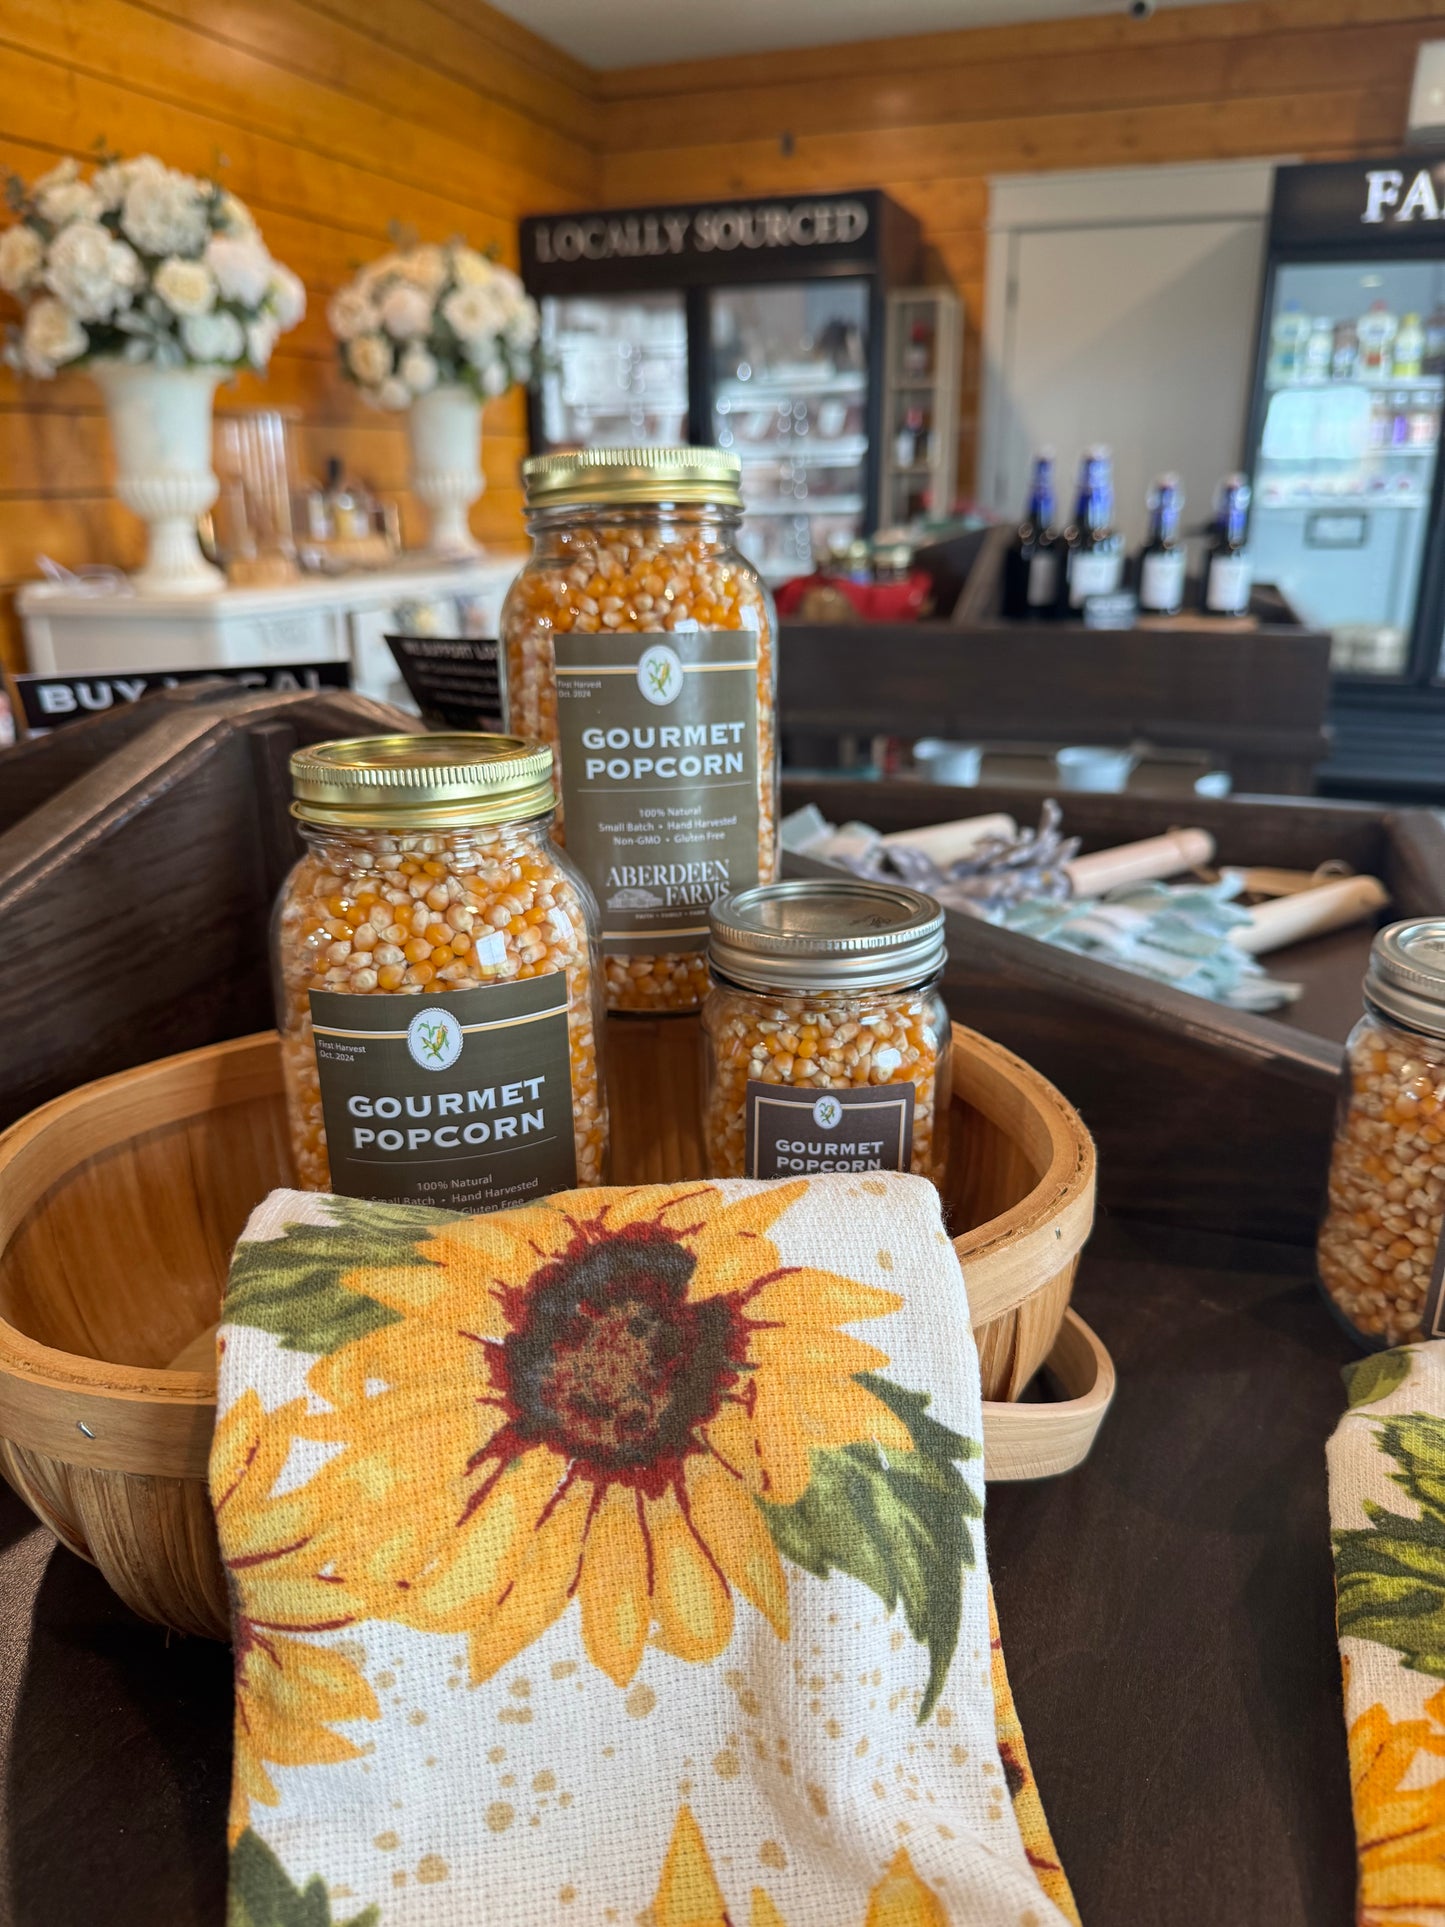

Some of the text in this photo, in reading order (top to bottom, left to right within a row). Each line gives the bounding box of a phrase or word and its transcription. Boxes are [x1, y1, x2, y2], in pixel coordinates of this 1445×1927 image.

[1361, 169, 1445, 223] FA
[535, 202, 869, 263] LOCALLY SOURCED
[37, 679, 146, 714] BUY
[581, 721, 746, 750] GOURMET
[585, 751, 744, 780] POPCORN
[598, 815, 738, 833] Small Batch Hand Harvested
[639, 805, 702, 818] 100% Natural
[613, 831, 725, 846] Non-GMO Gluten Free
[605, 858, 730, 888] ABERDEEN
[665, 880, 731, 907] FARMS
[318, 1039, 366, 1053] First Harvest
[319, 1050, 355, 1062] Oct. 2024
[347, 1075, 546, 1119] GOURMET
[353, 1108, 545, 1151] POPCORN
[775, 1139, 884, 1156] GOURMET
[776, 1156, 881, 1173] POPCORN
[403, 1196, 435, 1206] Batch
[452, 1190, 482, 1204] Hand
[484, 1178, 539, 1199] Harvested
[417, 1174, 492, 1191] 100% Natural
[461, 1196, 525, 1214] Gluten Free
